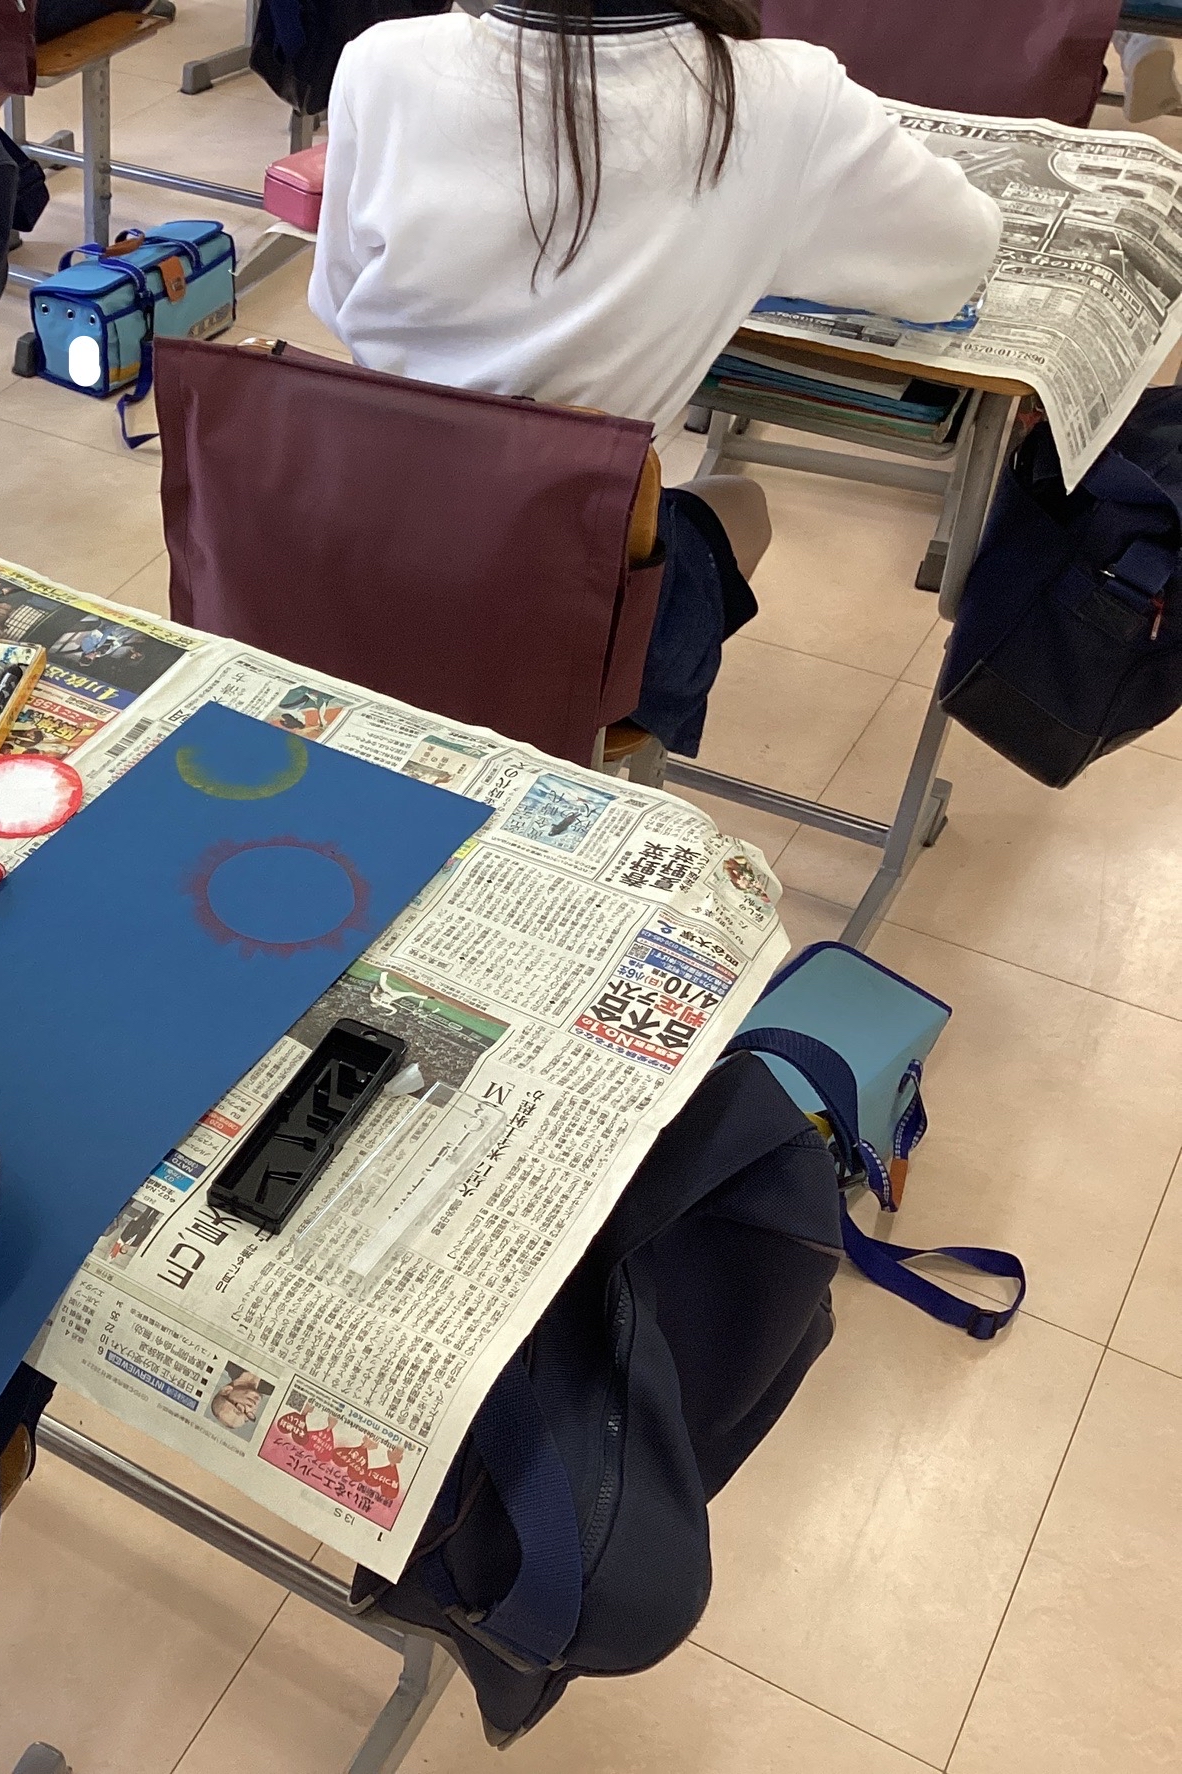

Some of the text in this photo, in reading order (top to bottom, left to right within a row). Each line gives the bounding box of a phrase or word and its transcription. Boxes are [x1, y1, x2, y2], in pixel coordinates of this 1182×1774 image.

[35, 712, 81, 743] 阪神
[618, 835, 671, 893] 春野菜
[648, 841, 700, 896] 夏野菜
[679, 927, 740, 967] 四谷大塚
[616, 963, 645, 982] 小6生
[661, 973, 720, 1014] 4/10
[586, 988, 696, 1055] 合不合
[604, 975, 708, 1030] 判定テスト
[574, 1027, 671, 1070] 中学受験をするなら
[484, 1085, 547, 1164] 米全土射程か
[169, 1156, 195, 1173] NATO
[77, 1278, 106, 1298] エンタメ
[213, 1242, 259, 1294] 10月にも施行
[72, 1287, 101, 1308] スポーツ
[107, 1309, 121, 1322] 35
[94, 1344, 105, 1356] 6
[97, 1332, 195, 1393] 日野不正 処分受け入れ 10
[102, 1320, 202, 1381] 広島商 選抜辞退 22
[306, 1397, 396, 1451] https://ideamarket.yomiuri.co.jp
[346, 1408, 403, 1445] idea market
[272, 1435, 358, 1487] クラウドファンディング
[283, 1454, 374, 1513] 想いをエールに
